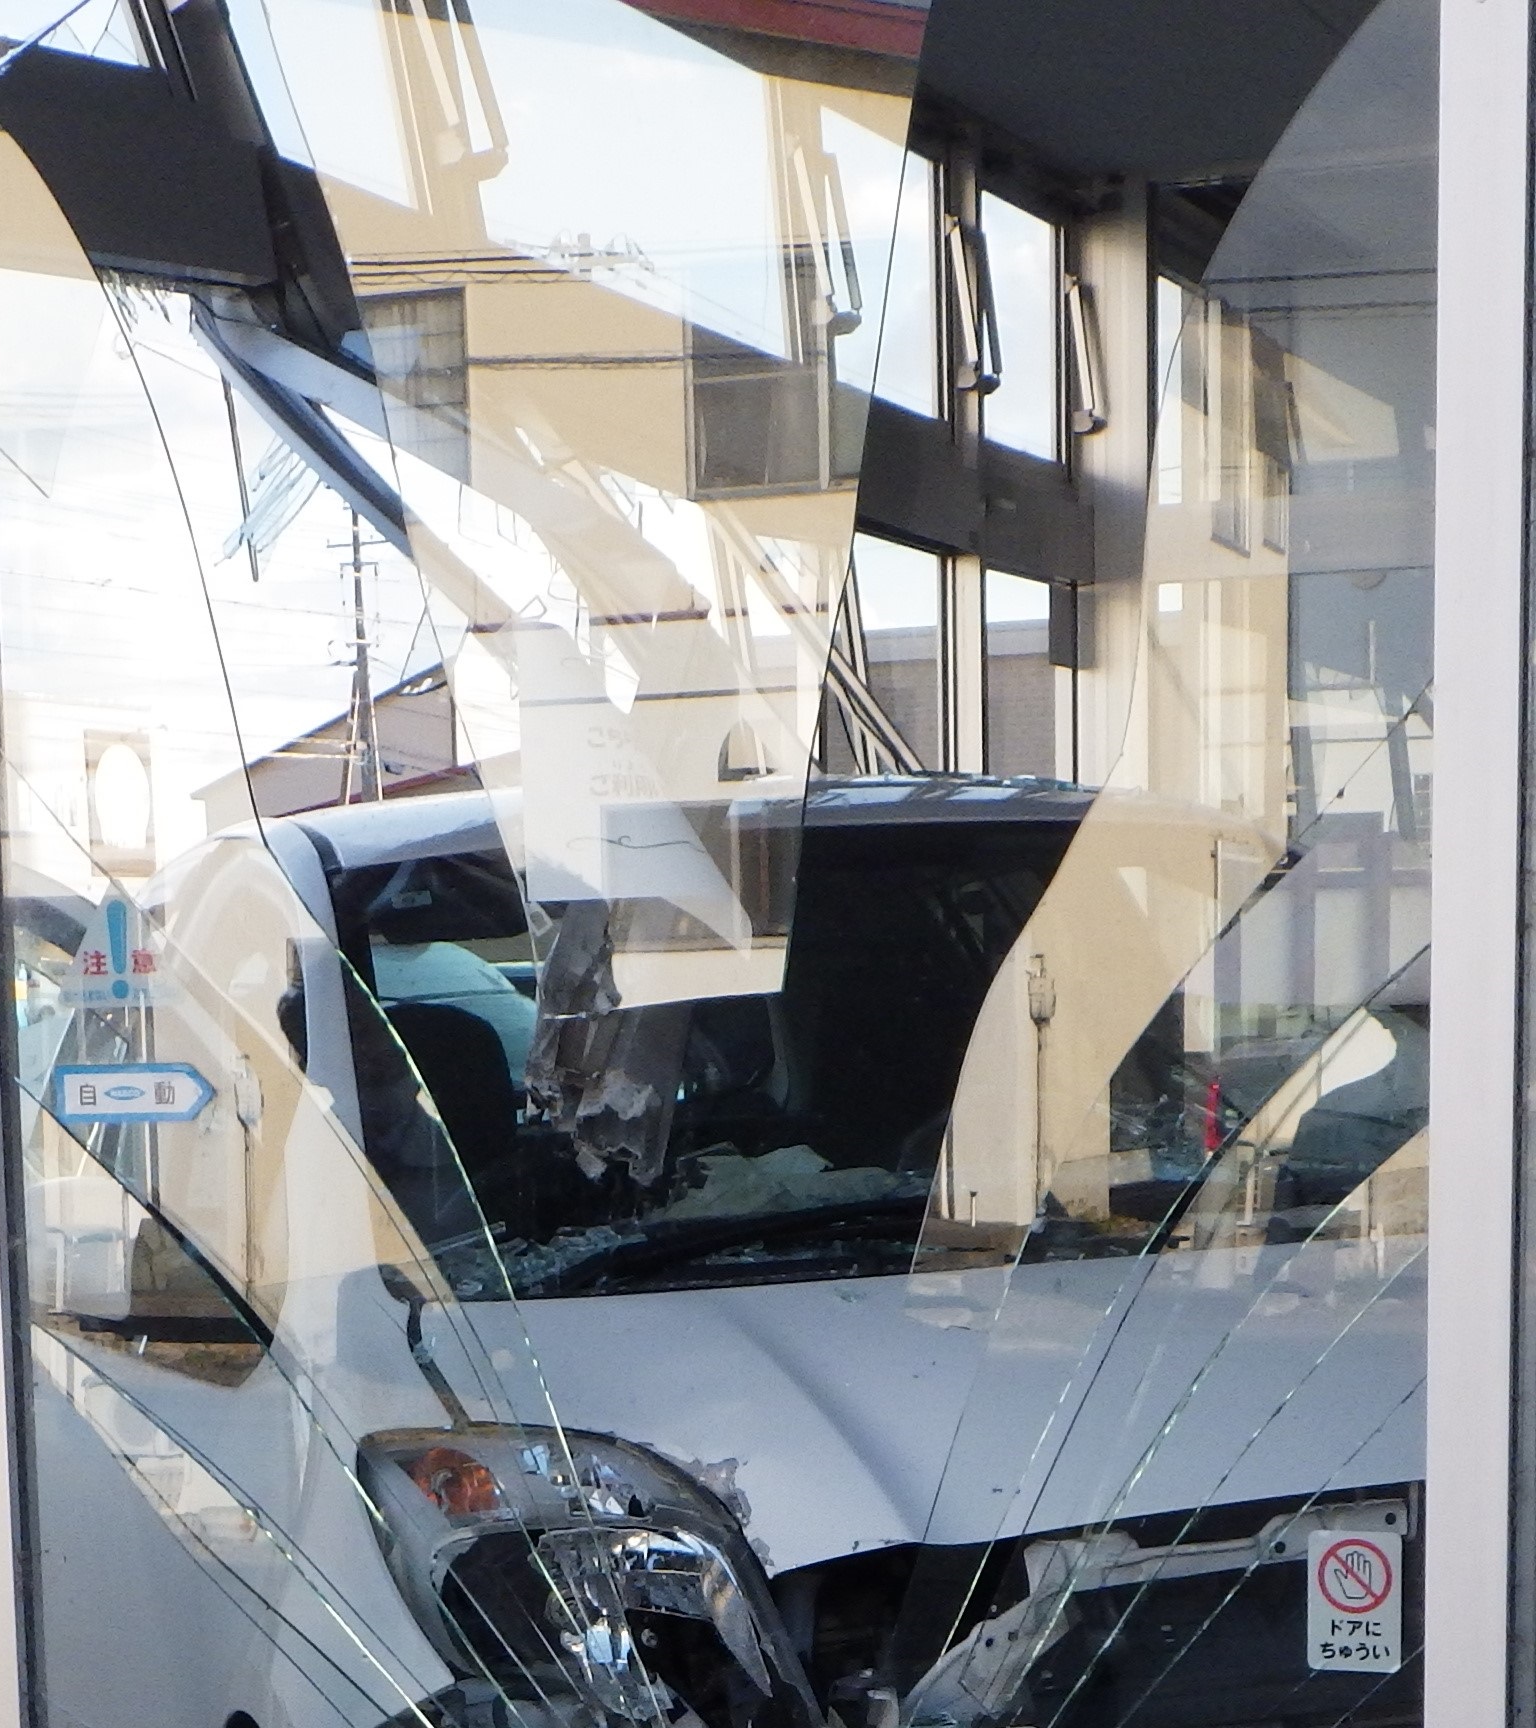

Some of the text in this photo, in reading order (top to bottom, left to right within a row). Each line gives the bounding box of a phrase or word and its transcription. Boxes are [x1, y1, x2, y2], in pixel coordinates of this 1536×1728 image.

[1329, 1618, 1382, 1638] ドアに
[1319, 1641, 1391, 1662] ちゅうい
